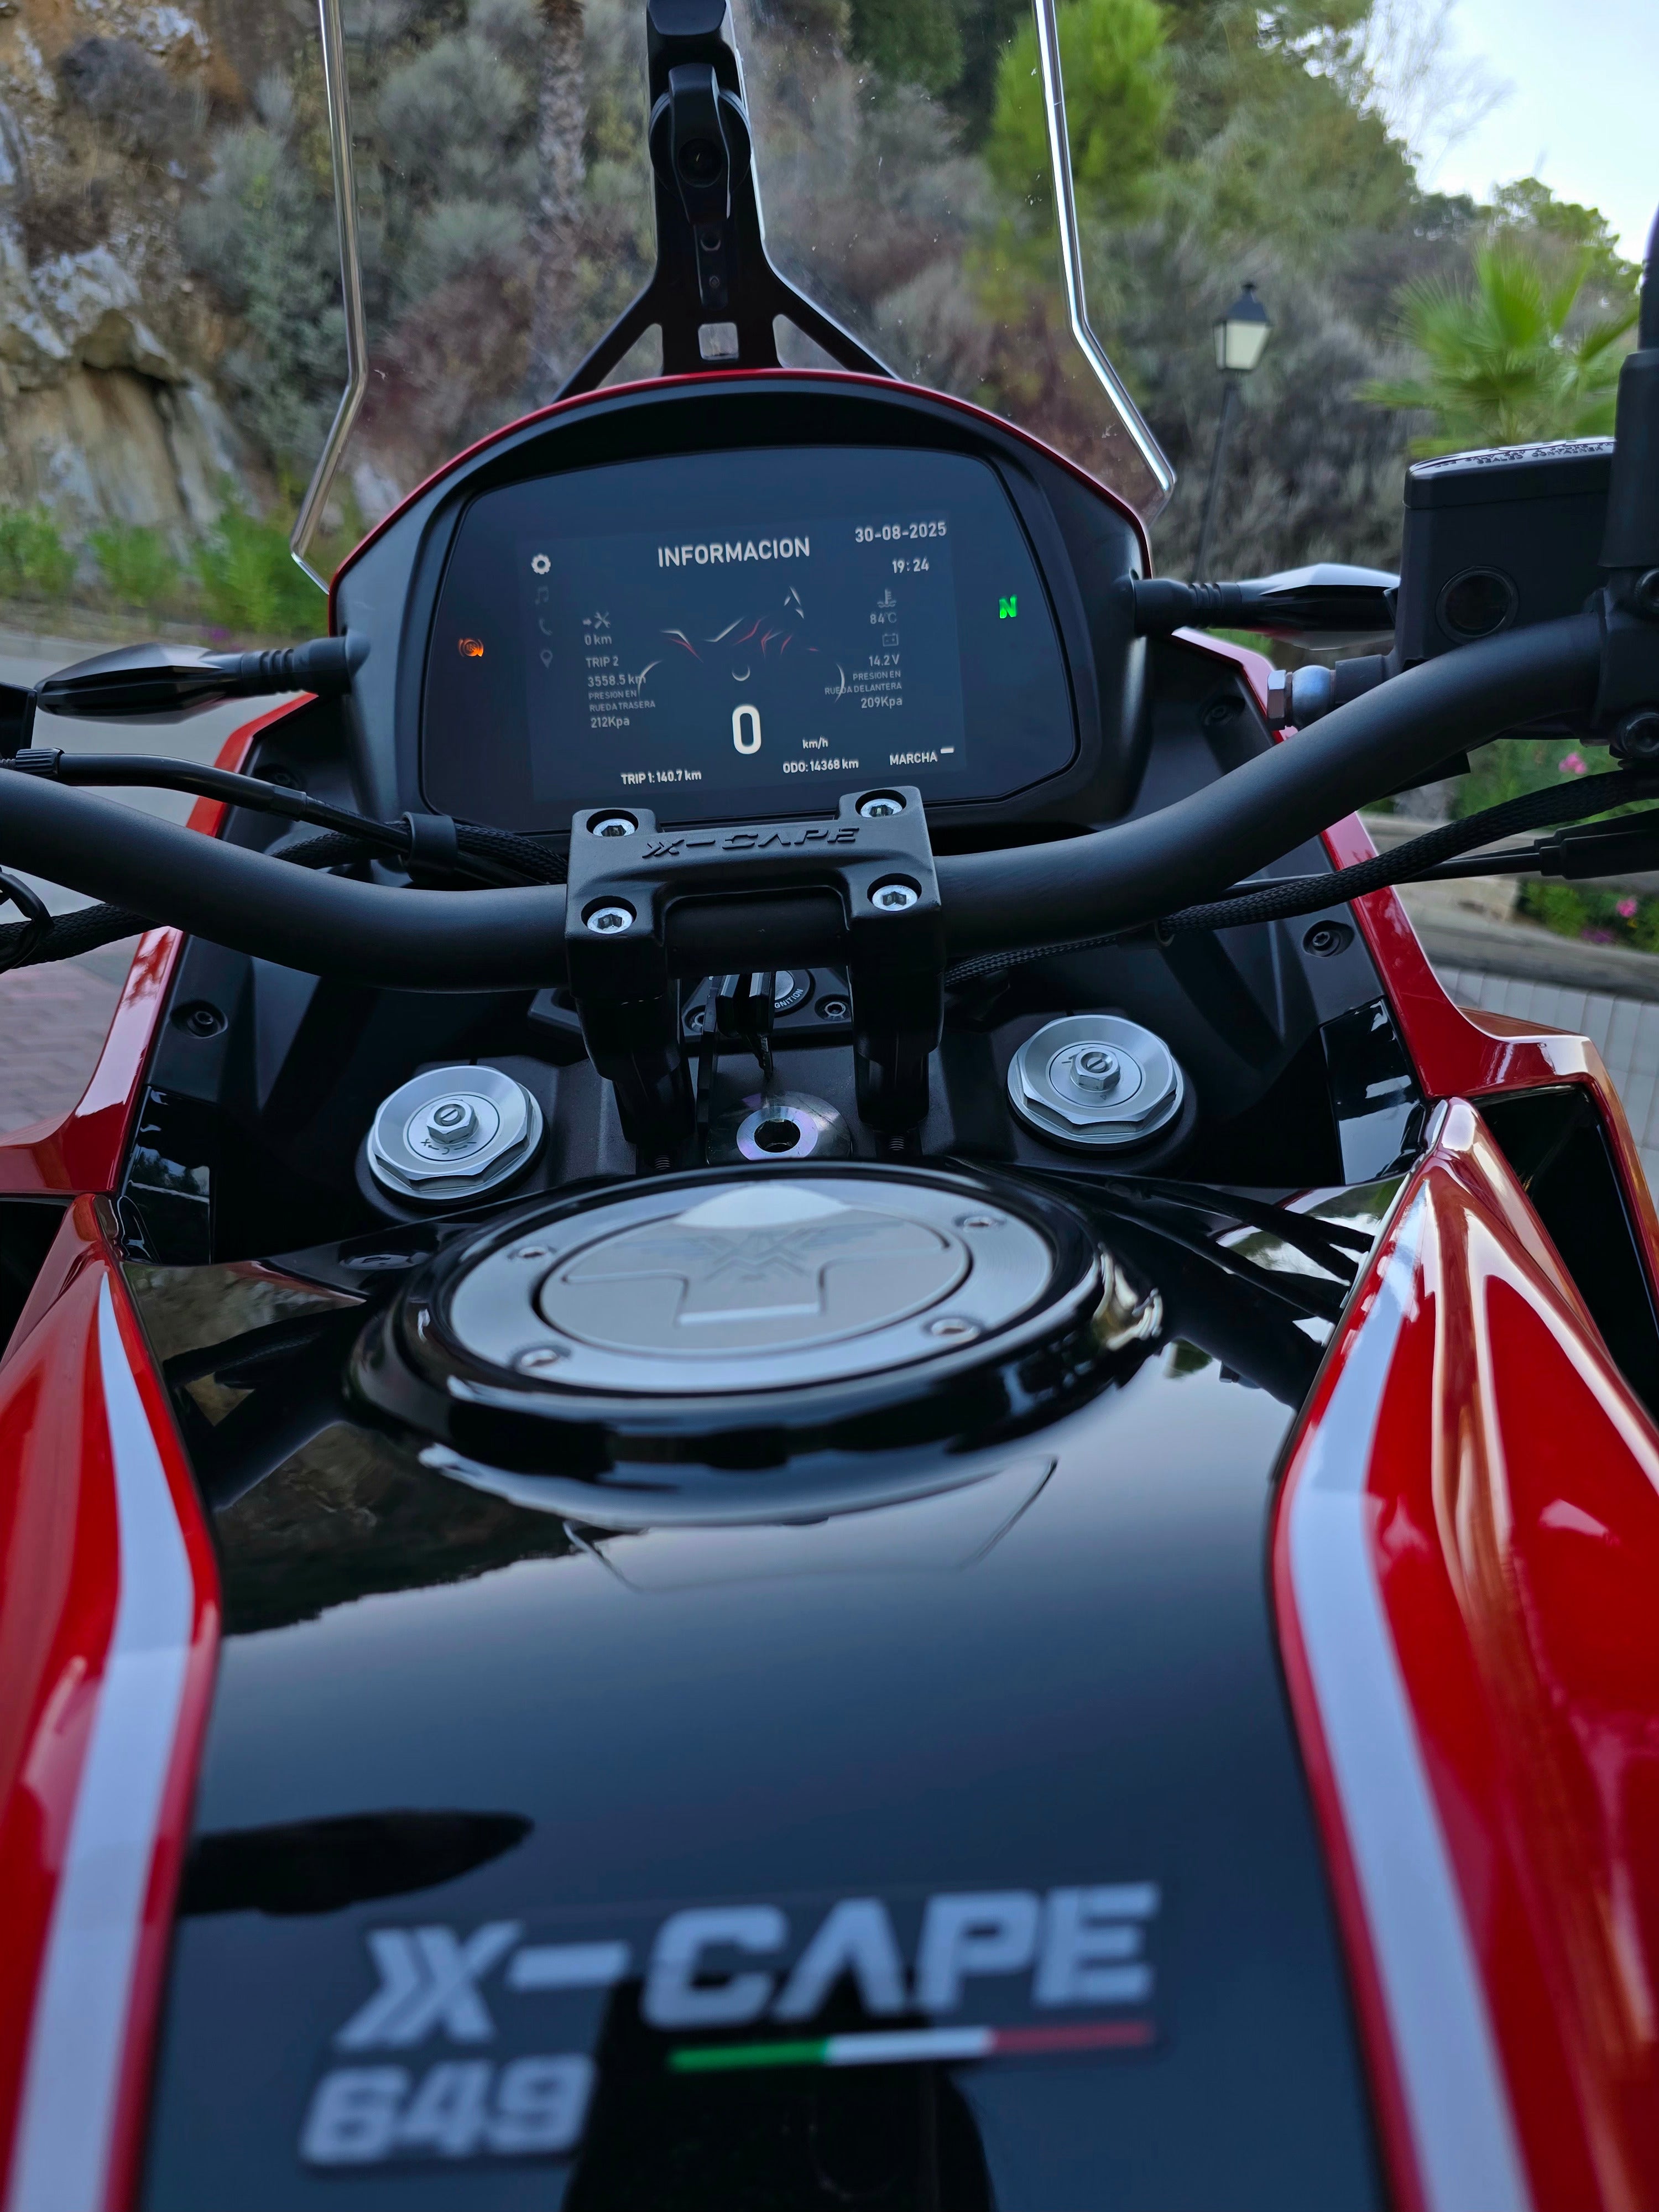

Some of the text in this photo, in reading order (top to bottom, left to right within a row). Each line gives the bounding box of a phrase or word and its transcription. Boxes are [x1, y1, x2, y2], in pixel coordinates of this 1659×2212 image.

[855, 520, 947, 542] 30-08-2025
[658, 537, 810, 567] INFORMACION
[892, 556, 929, 573] 19:24
[999, 594, 1016, 618] N
[584, 634, 612, 645] 0 km
[585, 655, 619, 668] TRIP 2
[869, 654, 900, 666] 14.2 V
[587, 674, 646, 687] 3558.5 km
[853, 670, 901, 681] PRESION EN
[825, 682, 902, 695] RUEDA DELANTERA
[588, 691, 624, 700] PRESION
[589, 700, 656, 712] RUEDA TRASERA
[861, 696, 903, 709] 209Kpa
[591, 716, 630, 729] 212Kpa
[732, 703, 761, 754] 0
[802, 736, 828, 749] km/h
[889, 752, 938, 765] MARCHA
[782, 758, 859, 774] ODO: 14368 km
[621, 773, 646, 785] TRIP
[656, 769, 682, 782] 140.7
[685, 770, 702, 781] km
[642, 827, 859, 859] X-CAPE
[774, 989, 804, 1008] GNITION
[333, 1882, 1160, 2048] X-CAPE
[299, 2053, 596, 2166] 649
